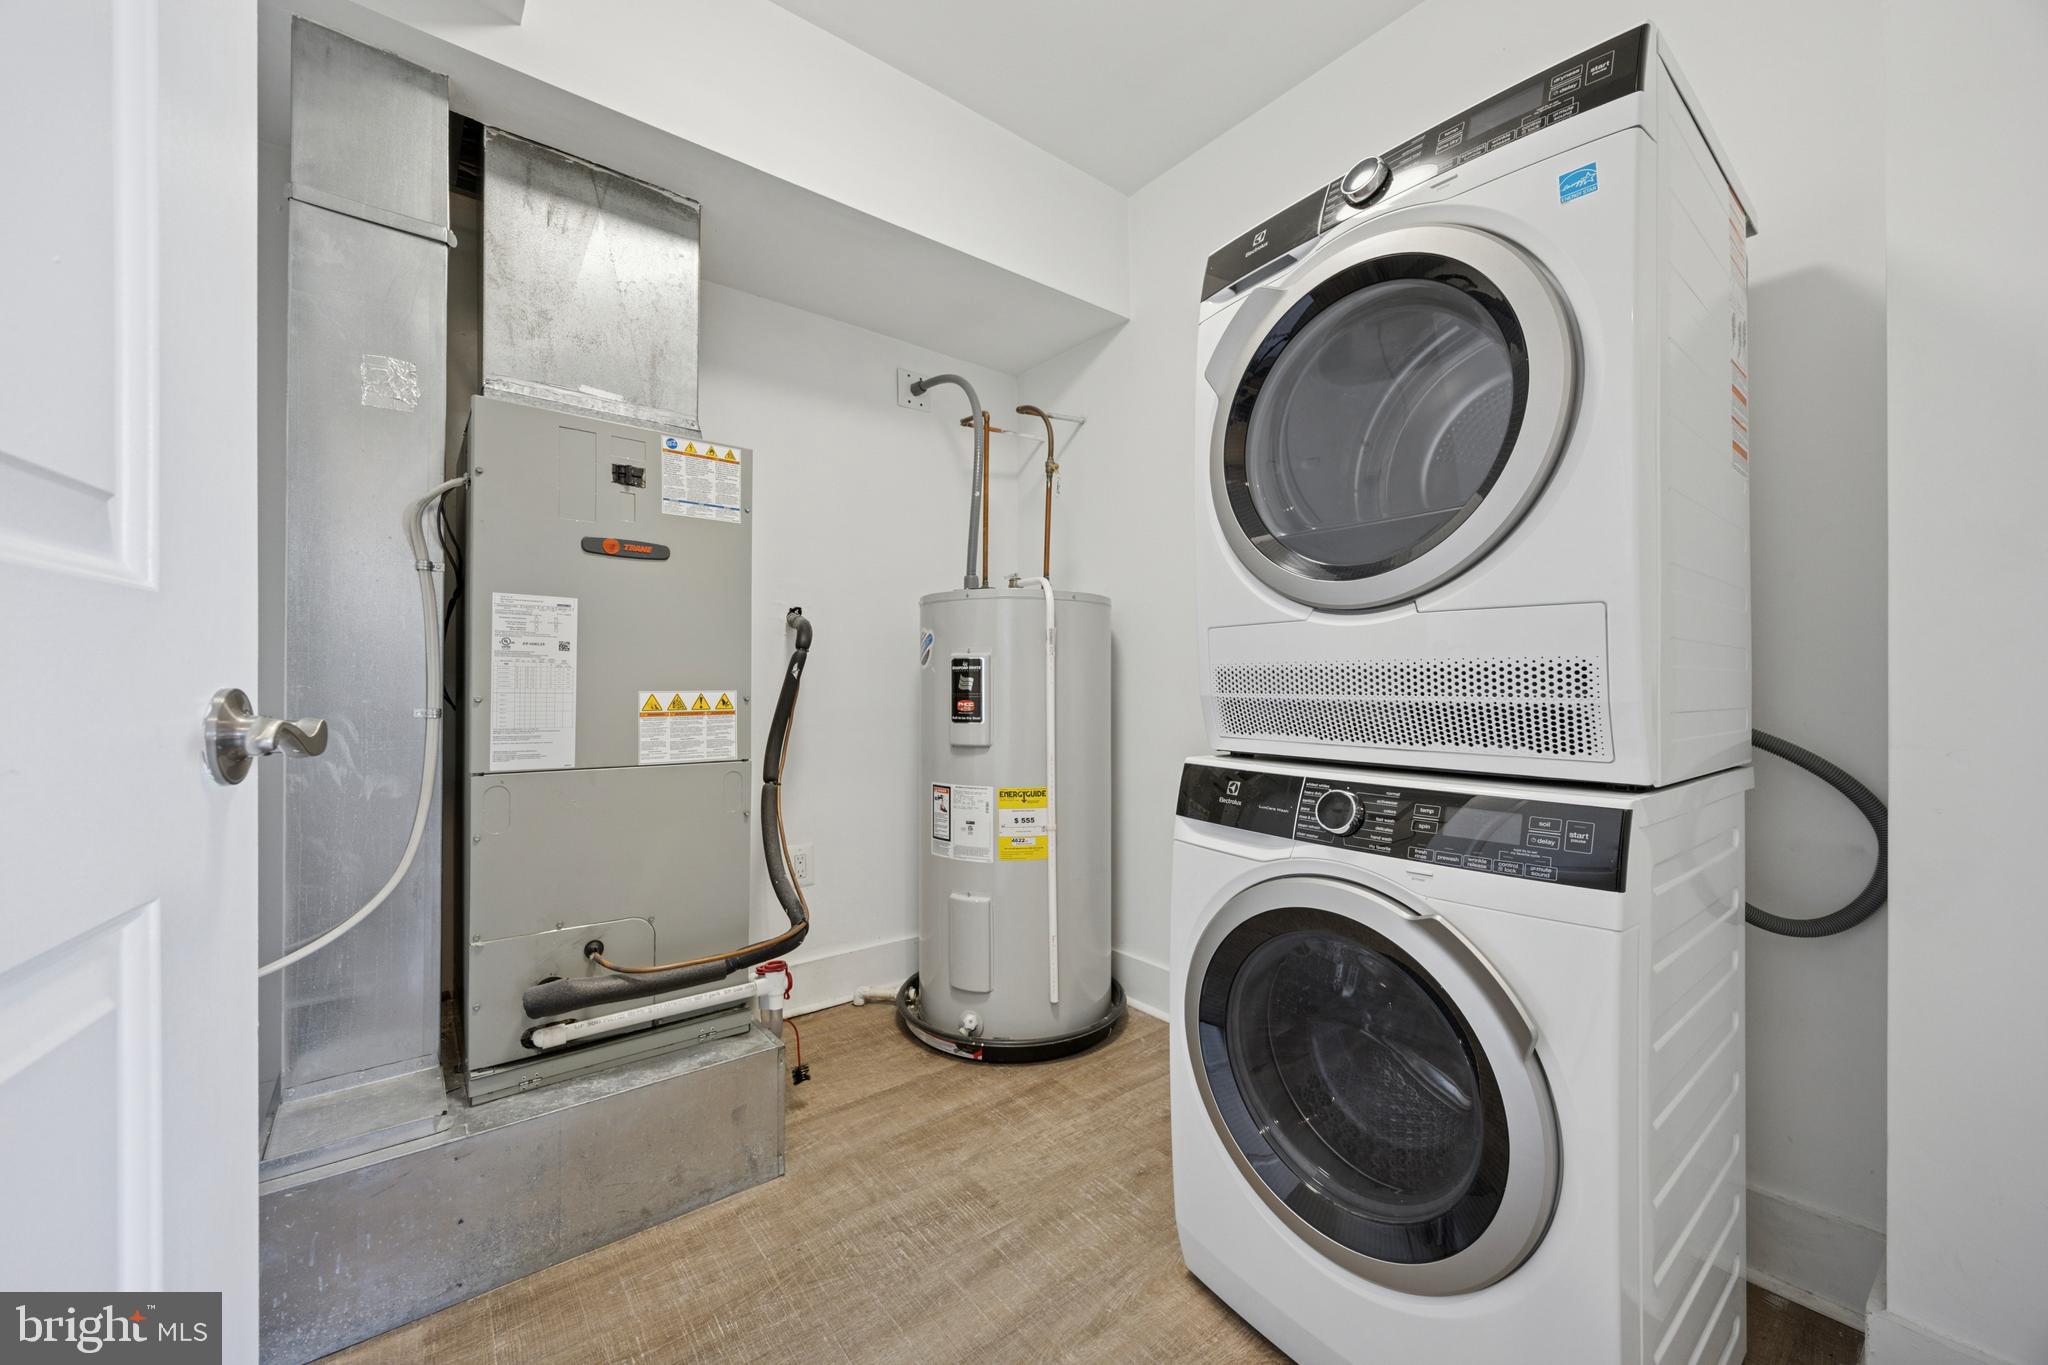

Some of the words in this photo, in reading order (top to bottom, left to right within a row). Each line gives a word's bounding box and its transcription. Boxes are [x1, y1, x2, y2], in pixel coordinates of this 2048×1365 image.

[1245, 241, 1268, 258] Electrolux
[623, 543, 654, 554] TRANE
[1219, 796, 1242, 806] Electrolux
[1568, 831, 1589, 840] start
[1536, 838, 1555, 846] delay
